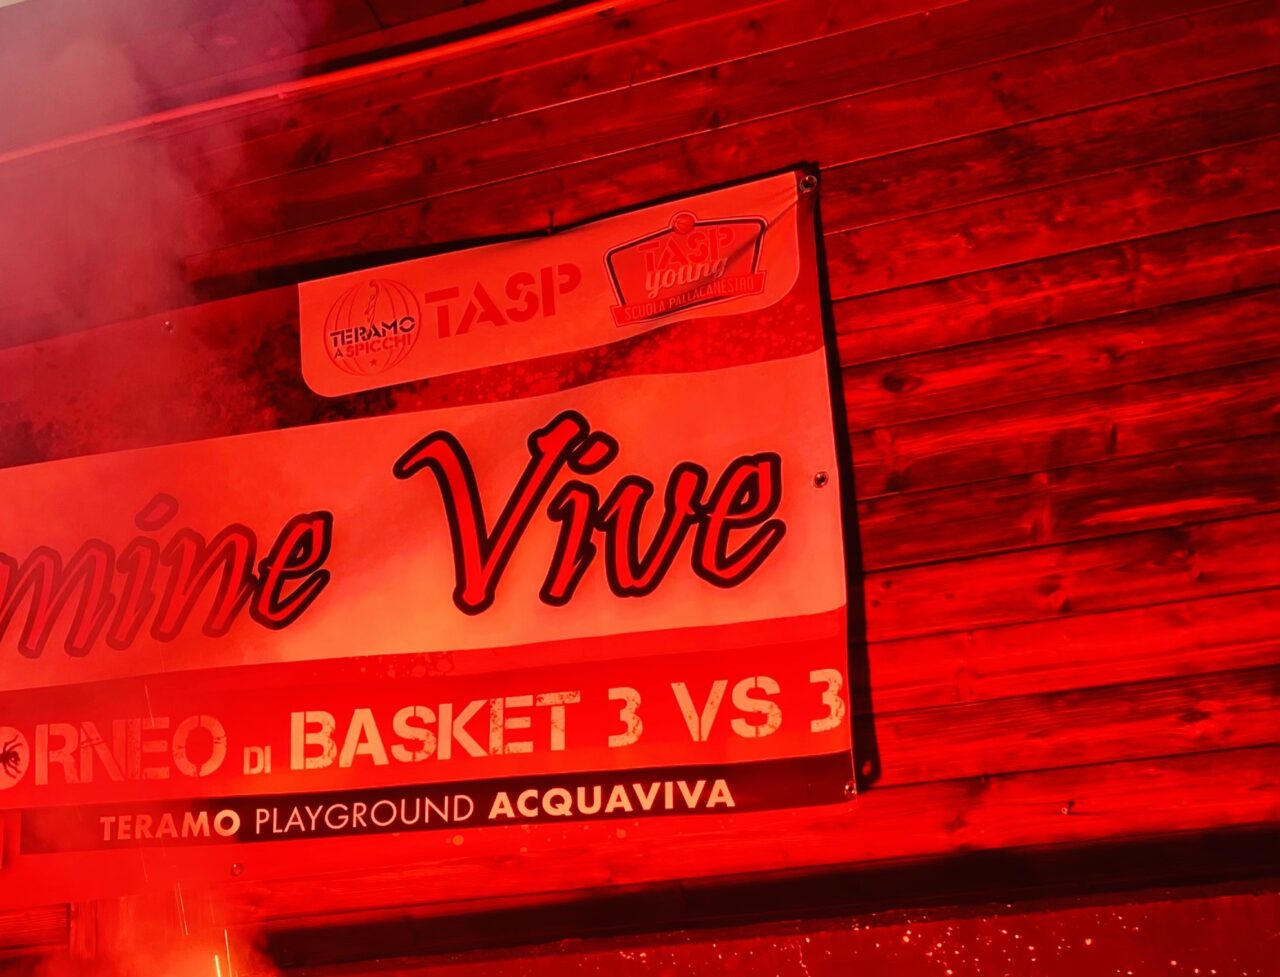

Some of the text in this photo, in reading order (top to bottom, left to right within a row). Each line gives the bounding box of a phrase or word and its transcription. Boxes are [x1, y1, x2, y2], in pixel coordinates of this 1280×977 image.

[637, 226, 736, 272] TASP
[624, 276, 755, 321] SCUOLA PALLACANESTRO
[645, 257, 729, 299] young
[424, 263, 582, 340] TASP
[330, 316, 416, 348] TERAMO
[334, 333, 411, 359] A SPICCHI
[392, 410, 786, 616] Vive
[243, 745, 271, 775] DI
[290, 689, 581, 771] BASKET
[607, 686, 643, 748] 3
[670, 675, 783, 742] VS
[809, 667, 847, 734] 3
[100, 779, 736, 841] TERAMO PLAYGROUND ACQUAVIVA
